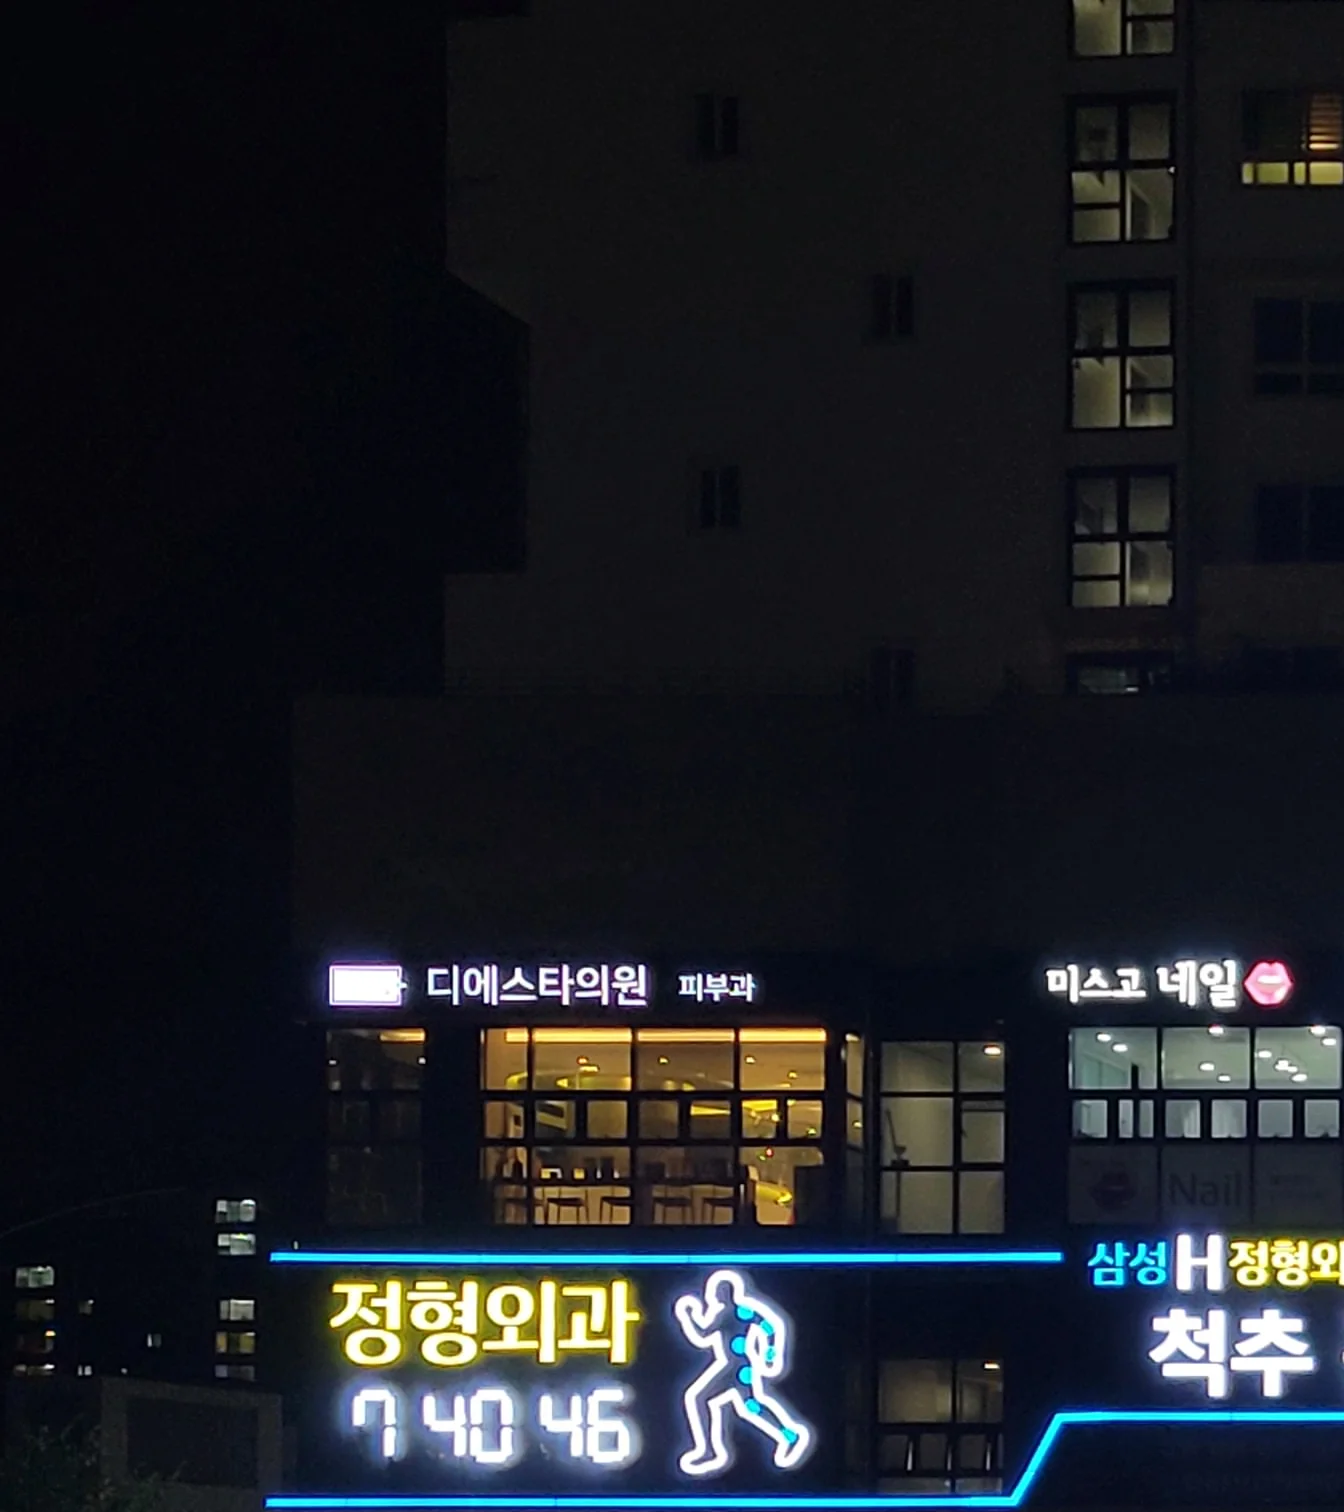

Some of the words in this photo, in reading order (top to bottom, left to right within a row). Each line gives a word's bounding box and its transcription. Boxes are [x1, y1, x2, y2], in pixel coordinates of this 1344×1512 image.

[427, 963, 647, 1006] 디에스타의원
[678, 972, 756, 1002] 피부과
[1046, 963, 1147, 1004] 미스고
[1156, 959, 1239, 1008] 네일
[330, 1280, 640, 1366] 정형외과
[1149, 1308, 1316, 1399] 척추
